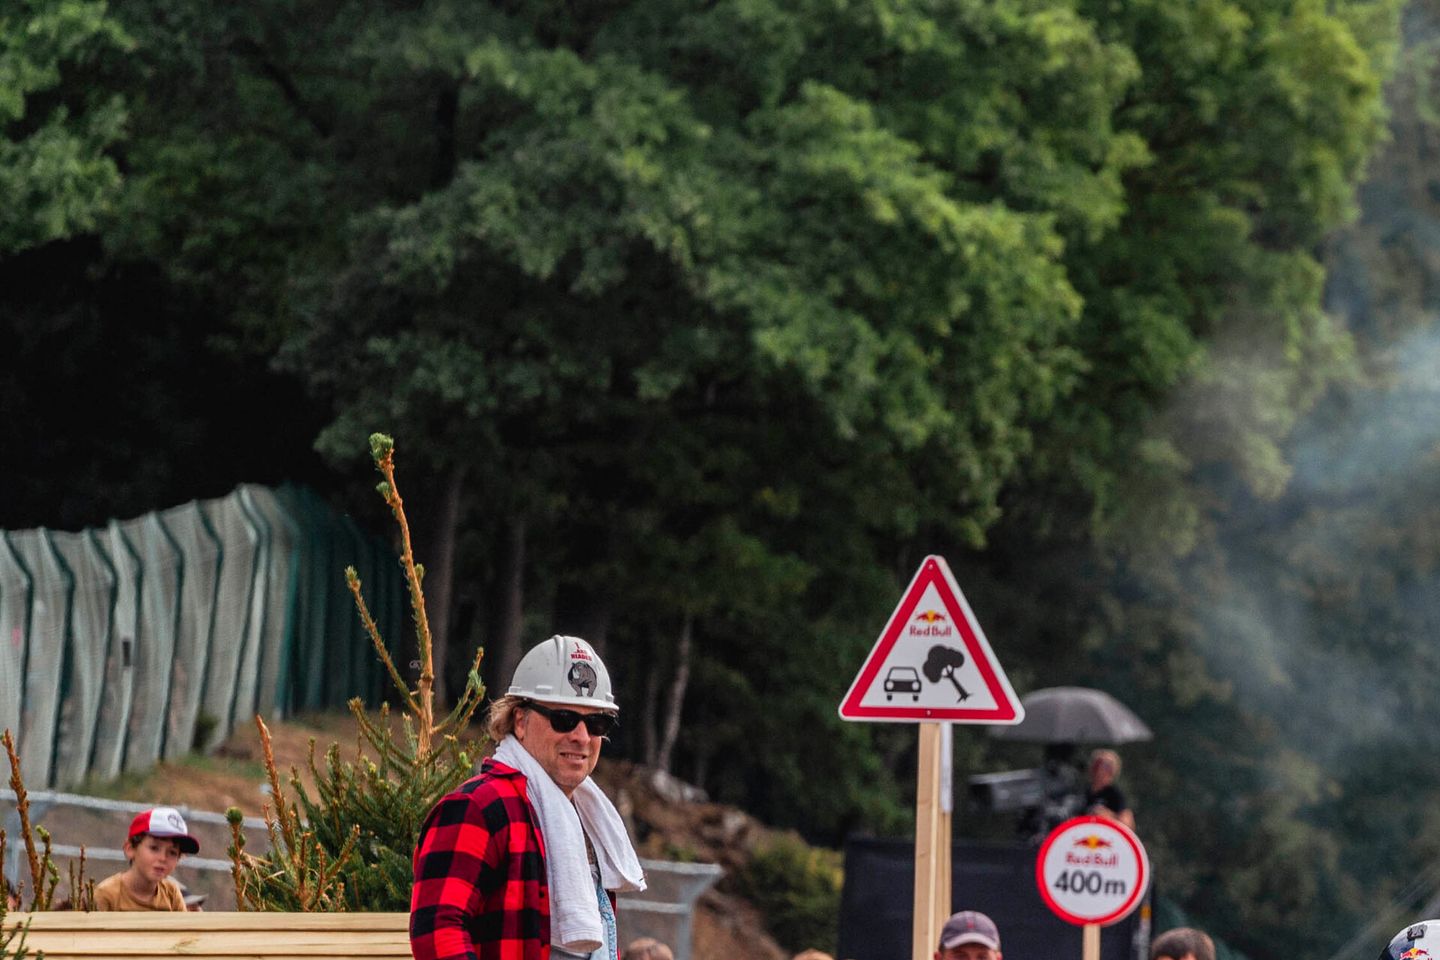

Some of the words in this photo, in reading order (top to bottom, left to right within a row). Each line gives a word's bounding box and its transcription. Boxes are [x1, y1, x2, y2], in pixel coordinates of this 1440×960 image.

[909, 625, 930, 637] Red
[932, 625, 952, 637] Bull
[1066, 852, 1092, 865] Red
[1094, 853, 1117, 866] Bull
[1054, 870, 1126, 894] 400m
